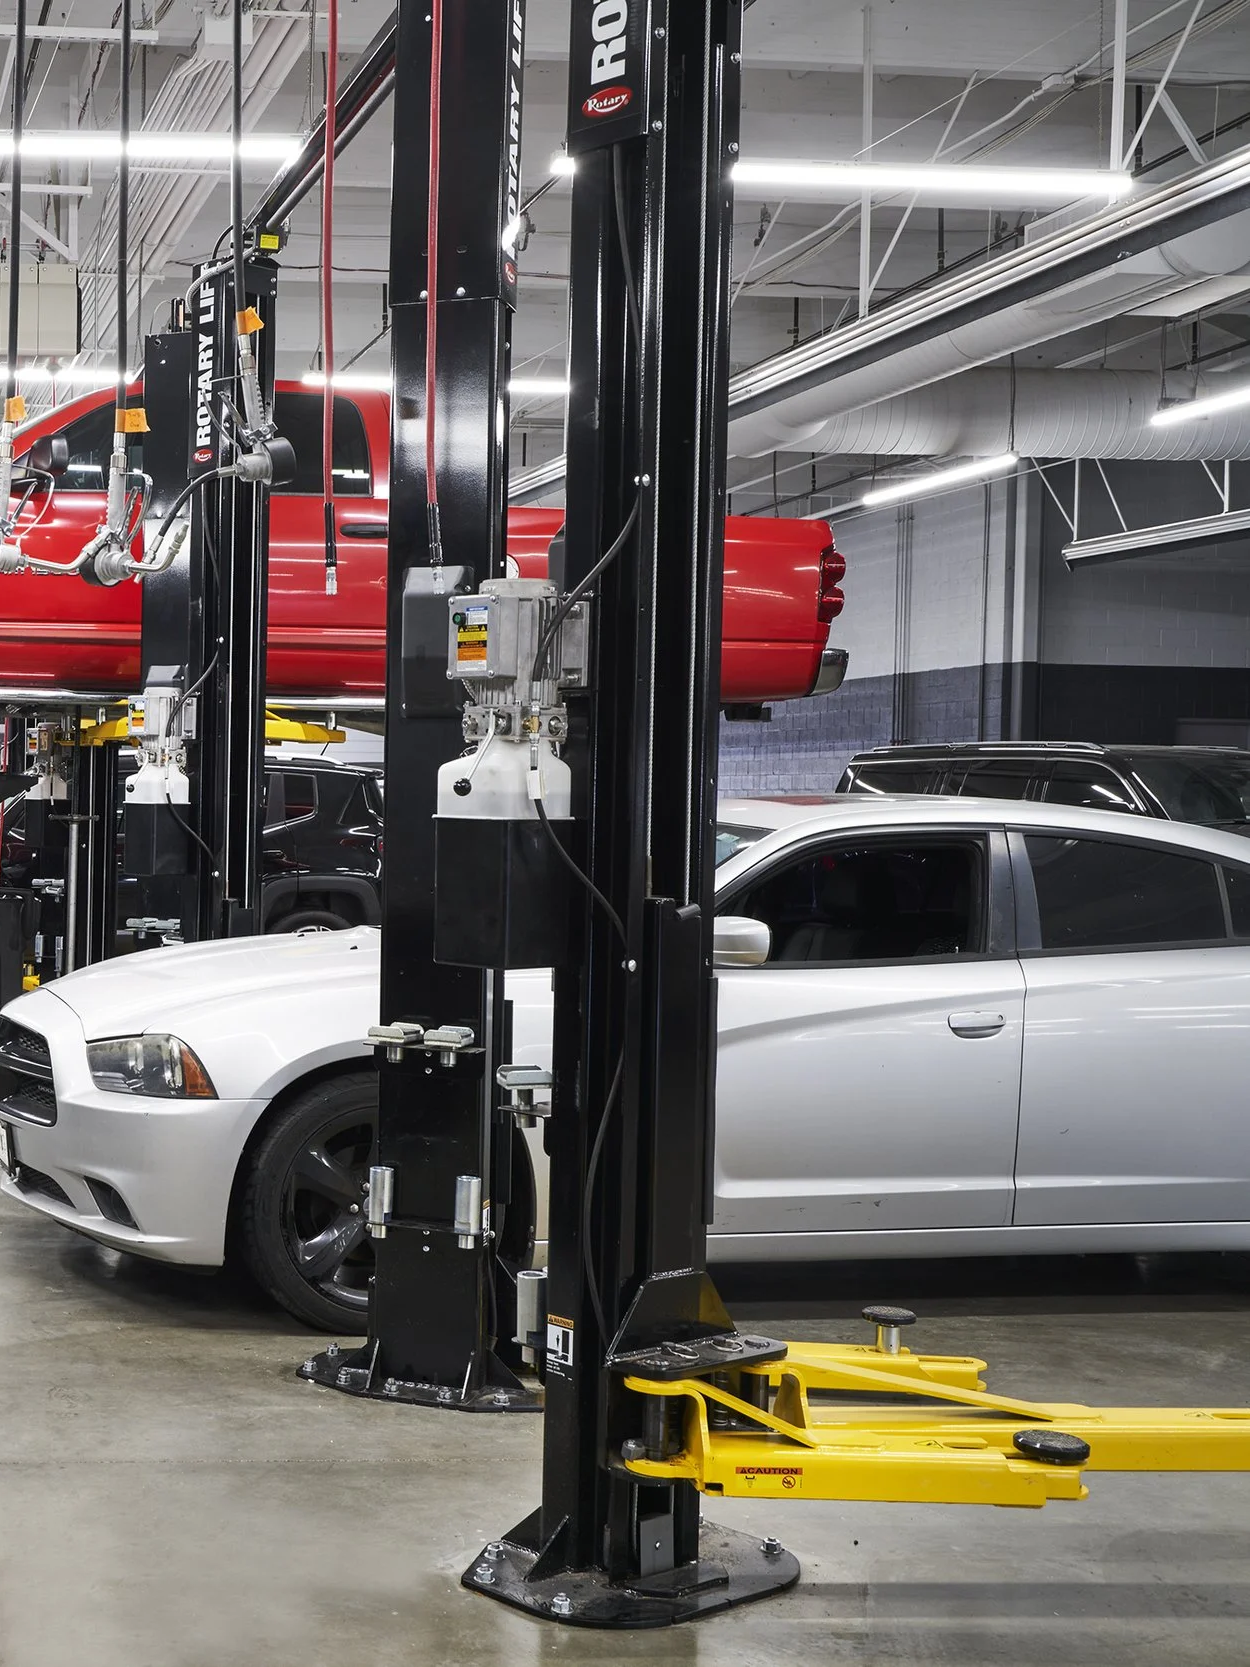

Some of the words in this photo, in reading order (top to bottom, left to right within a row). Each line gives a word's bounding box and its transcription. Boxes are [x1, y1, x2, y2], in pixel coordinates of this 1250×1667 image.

[512, 0, 522, 69] LIF
[591, 0, 628, 85] RO
[587, 94, 628, 112] Rotary
[196, 333, 214, 447] ROTARY
[553, 1315, 573, 1328] WARNING
[747, 1467, 798, 1475] CAUTION
